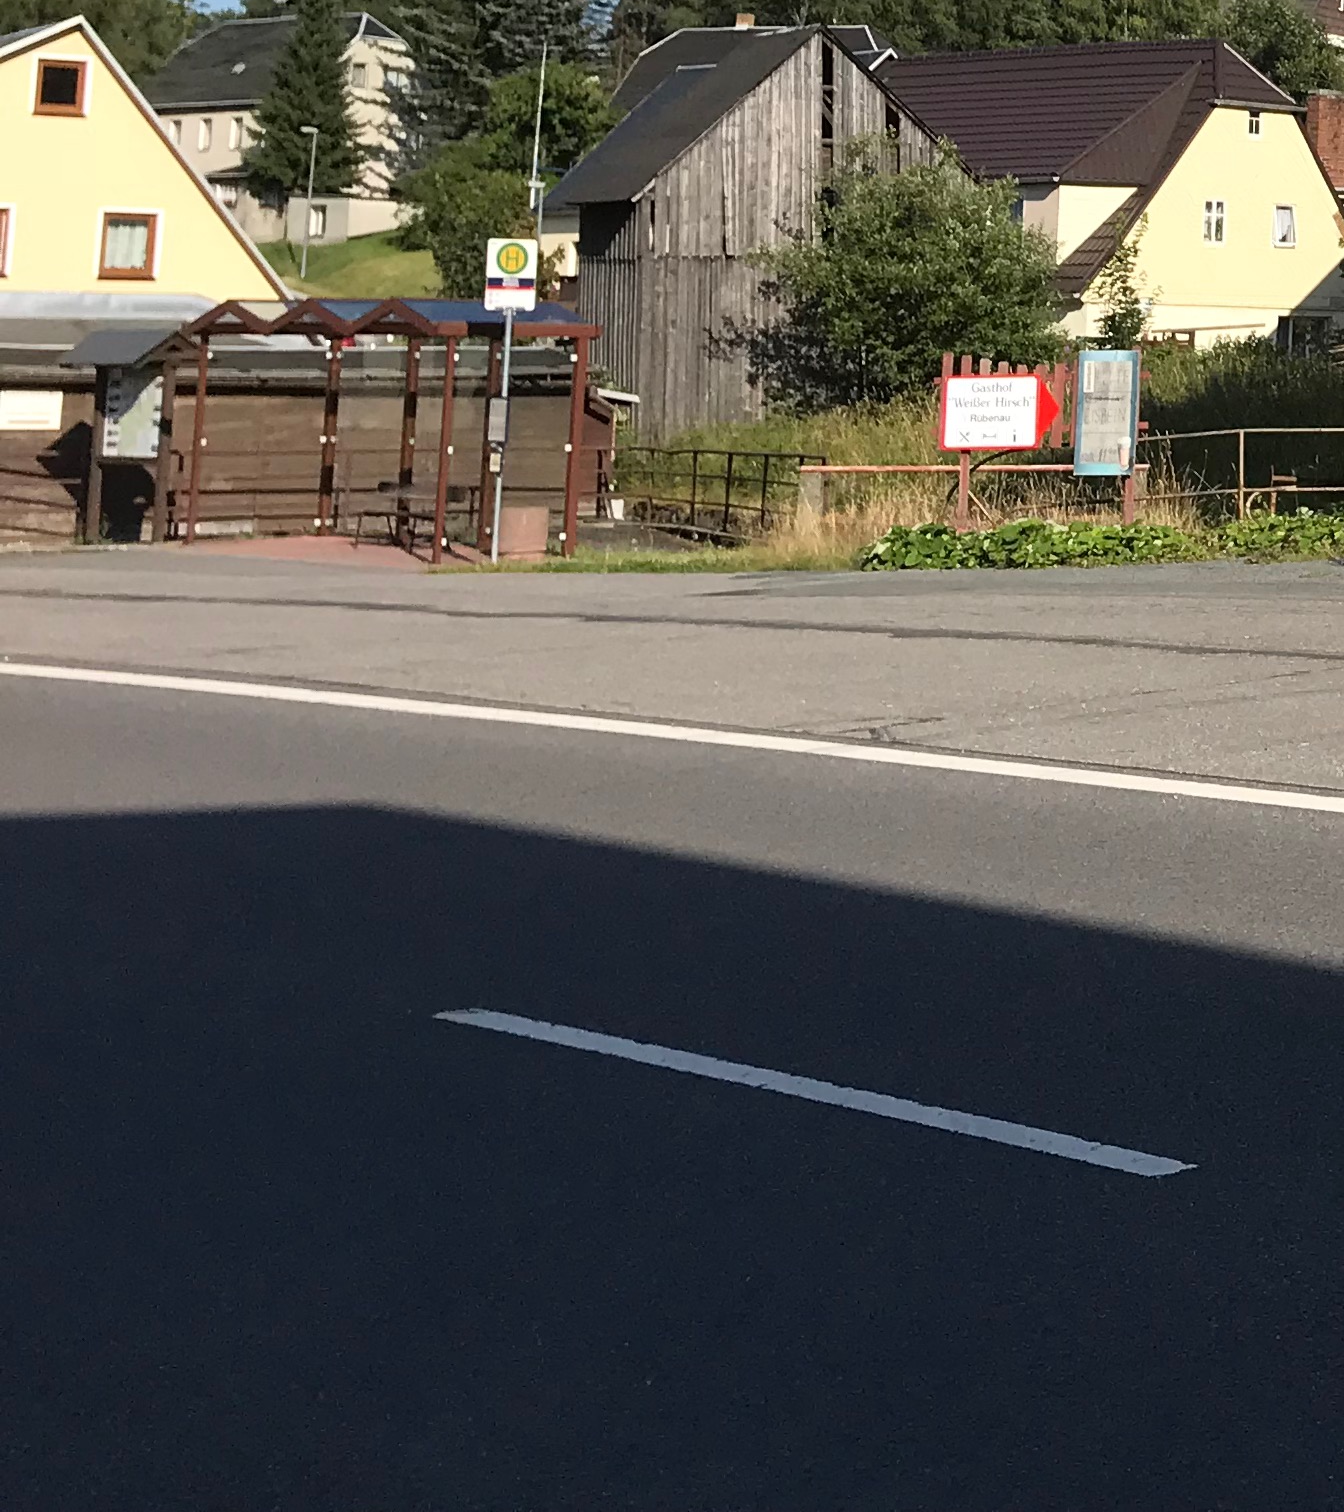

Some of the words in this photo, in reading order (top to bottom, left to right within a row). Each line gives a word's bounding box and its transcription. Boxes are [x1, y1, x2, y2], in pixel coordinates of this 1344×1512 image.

[505, 248, 520, 268] H
[971, 381, 1012, 393] Gasthof
[970, 413, 1011, 423] Rübenau
